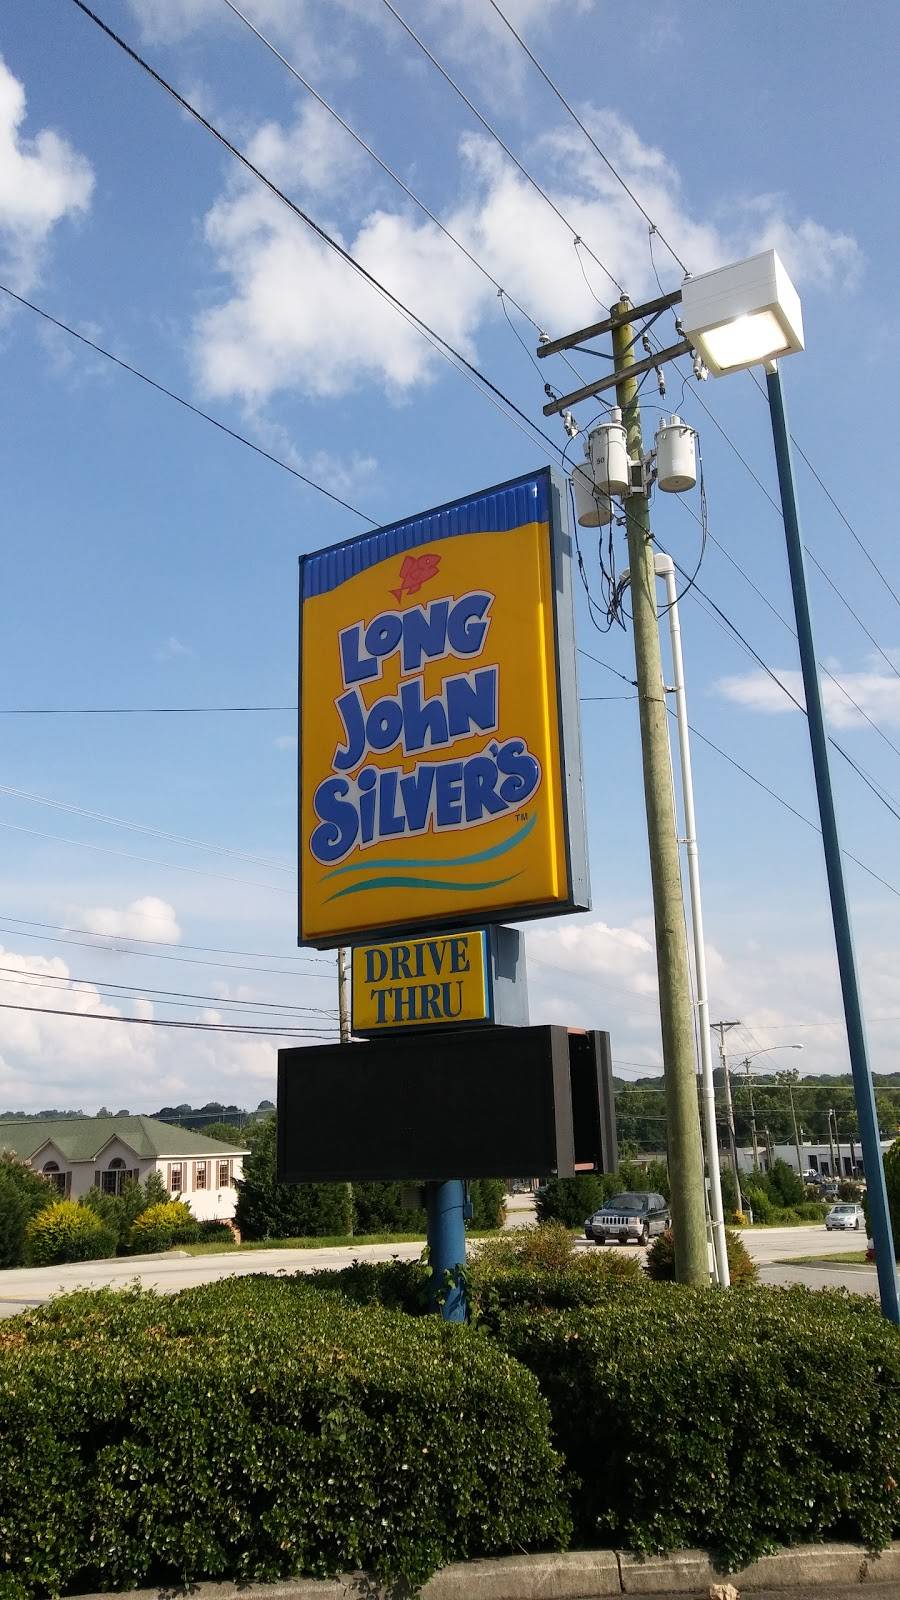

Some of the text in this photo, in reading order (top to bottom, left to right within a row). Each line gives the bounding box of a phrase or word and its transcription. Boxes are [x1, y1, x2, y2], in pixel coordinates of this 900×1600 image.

[339, 593, 493, 686] LONG
[364, 937, 470, 984] DRIVE
[370, 980, 464, 1024] THRU
